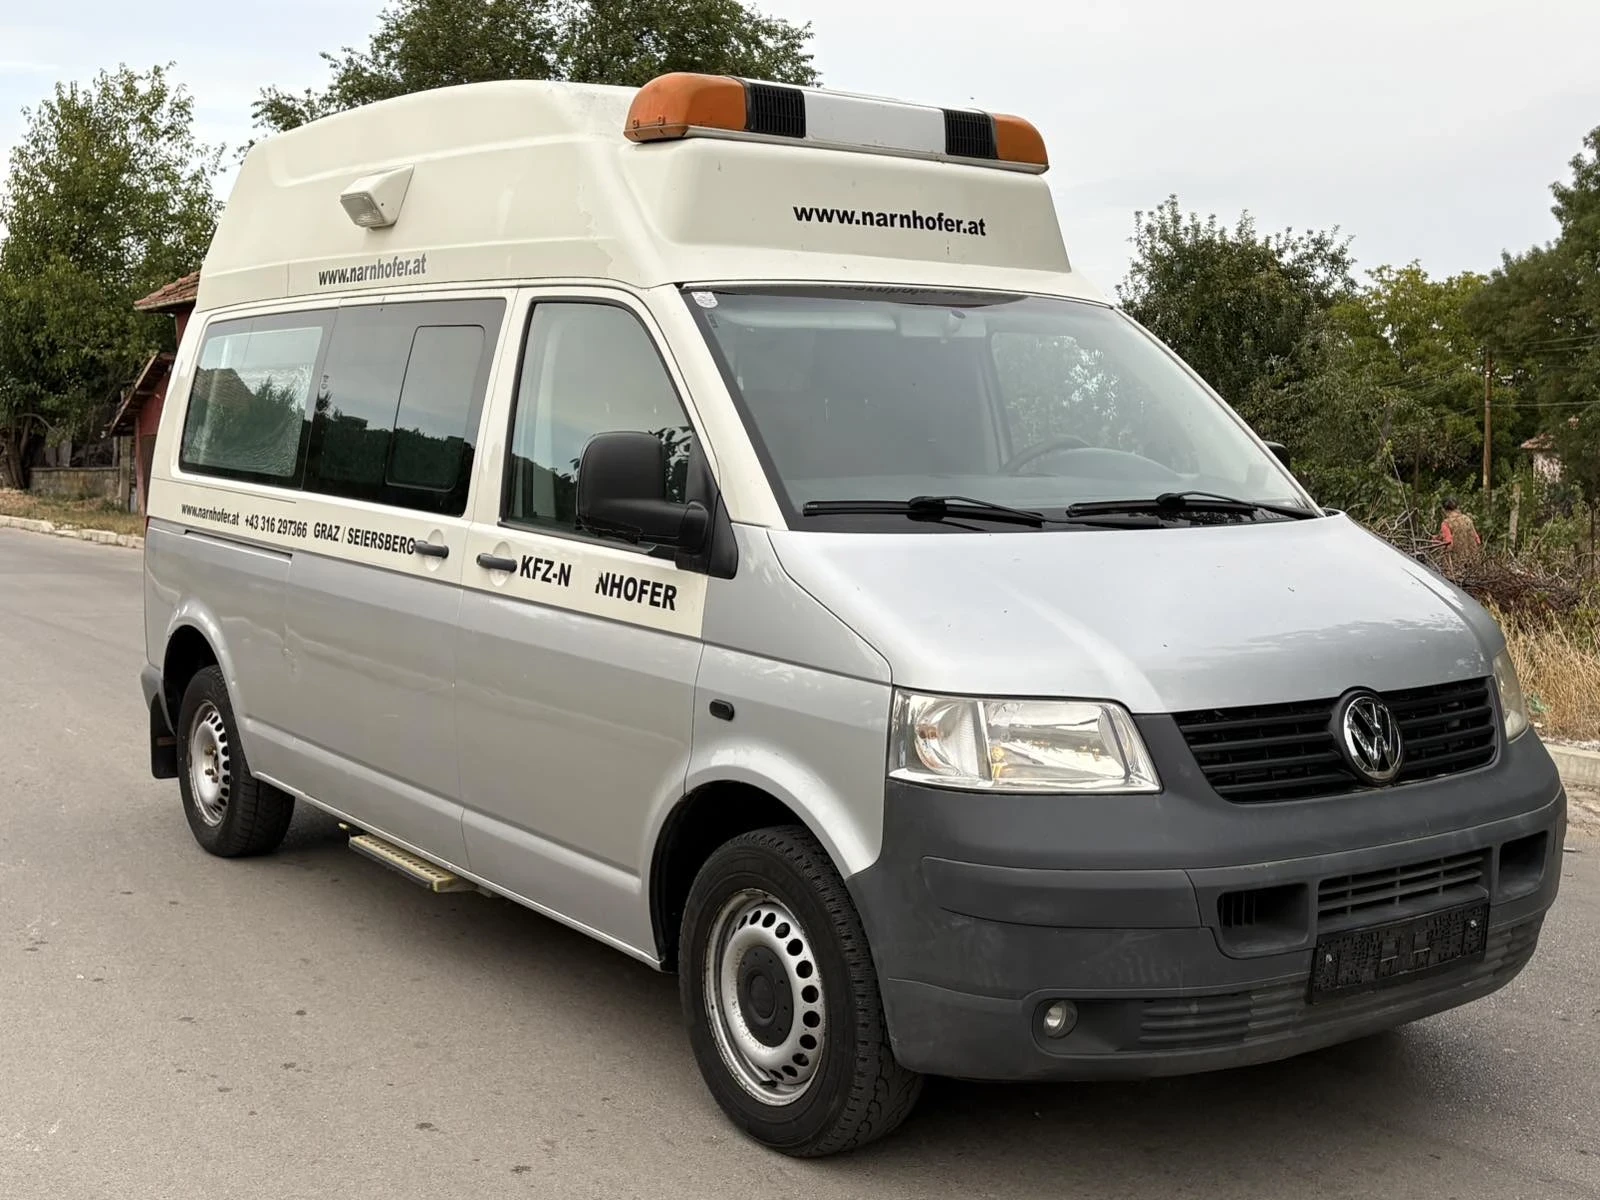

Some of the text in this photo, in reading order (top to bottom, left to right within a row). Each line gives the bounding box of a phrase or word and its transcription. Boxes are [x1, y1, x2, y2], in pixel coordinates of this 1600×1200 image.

[793, 206, 986, 236] www.narnhofer.at
[318, 253, 427, 286] www.narnhofer.at
[181, 503, 240, 526] www.narnhofer.at
[245, 513, 260, 530] +43
[260, 515, 276, 533] 316
[277, 517, 308, 538] 297366
[313, 521, 341, 542] GRAZ
[347, 527, 416, 555] SEIERSBERG
[519, 554, 677, 611] KFZ-N NHOFER
